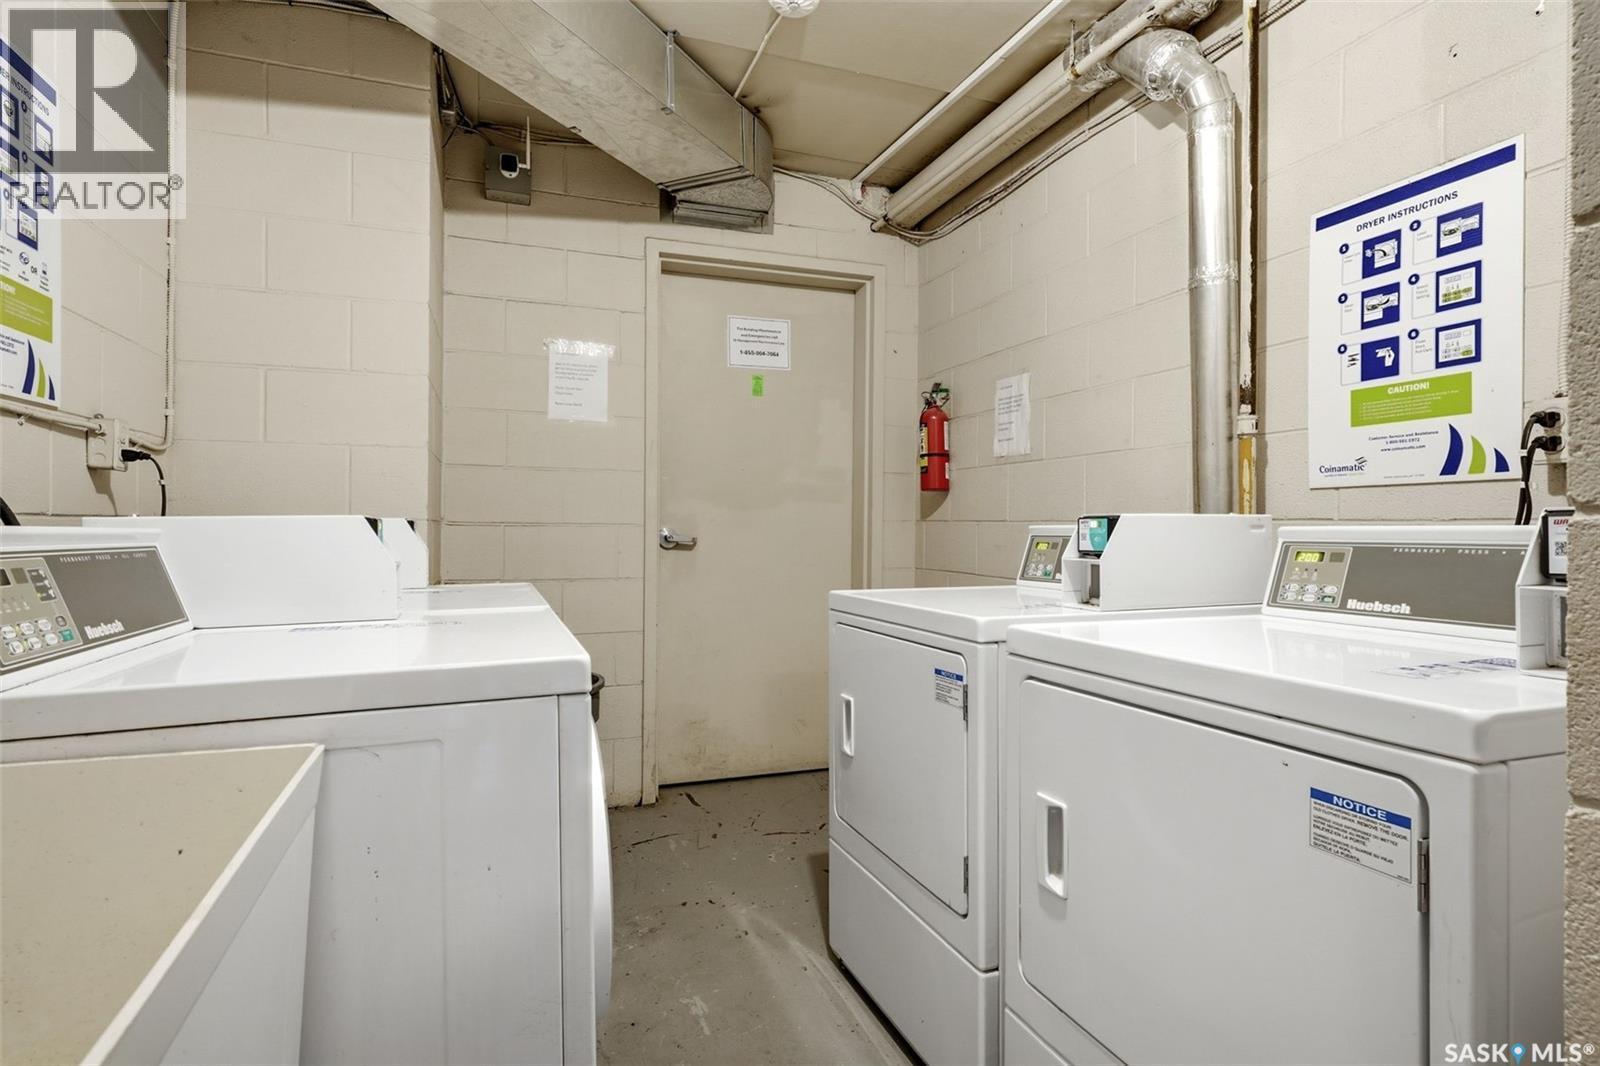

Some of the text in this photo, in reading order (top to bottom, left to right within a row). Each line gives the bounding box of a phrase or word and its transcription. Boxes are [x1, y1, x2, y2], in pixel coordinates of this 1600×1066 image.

[1356, 190, 1459, 232] DRYER INSTRUCTIONS
[1387, 381, 1430, 395] CAUTION!
[1319, 463, 1365, 474] Coinamatic
[1347, 599, 1411, 614] Huebsch
[84, 619, 125, 639] Huebsch
[1333, 796, 1387, 822] NOTICE
